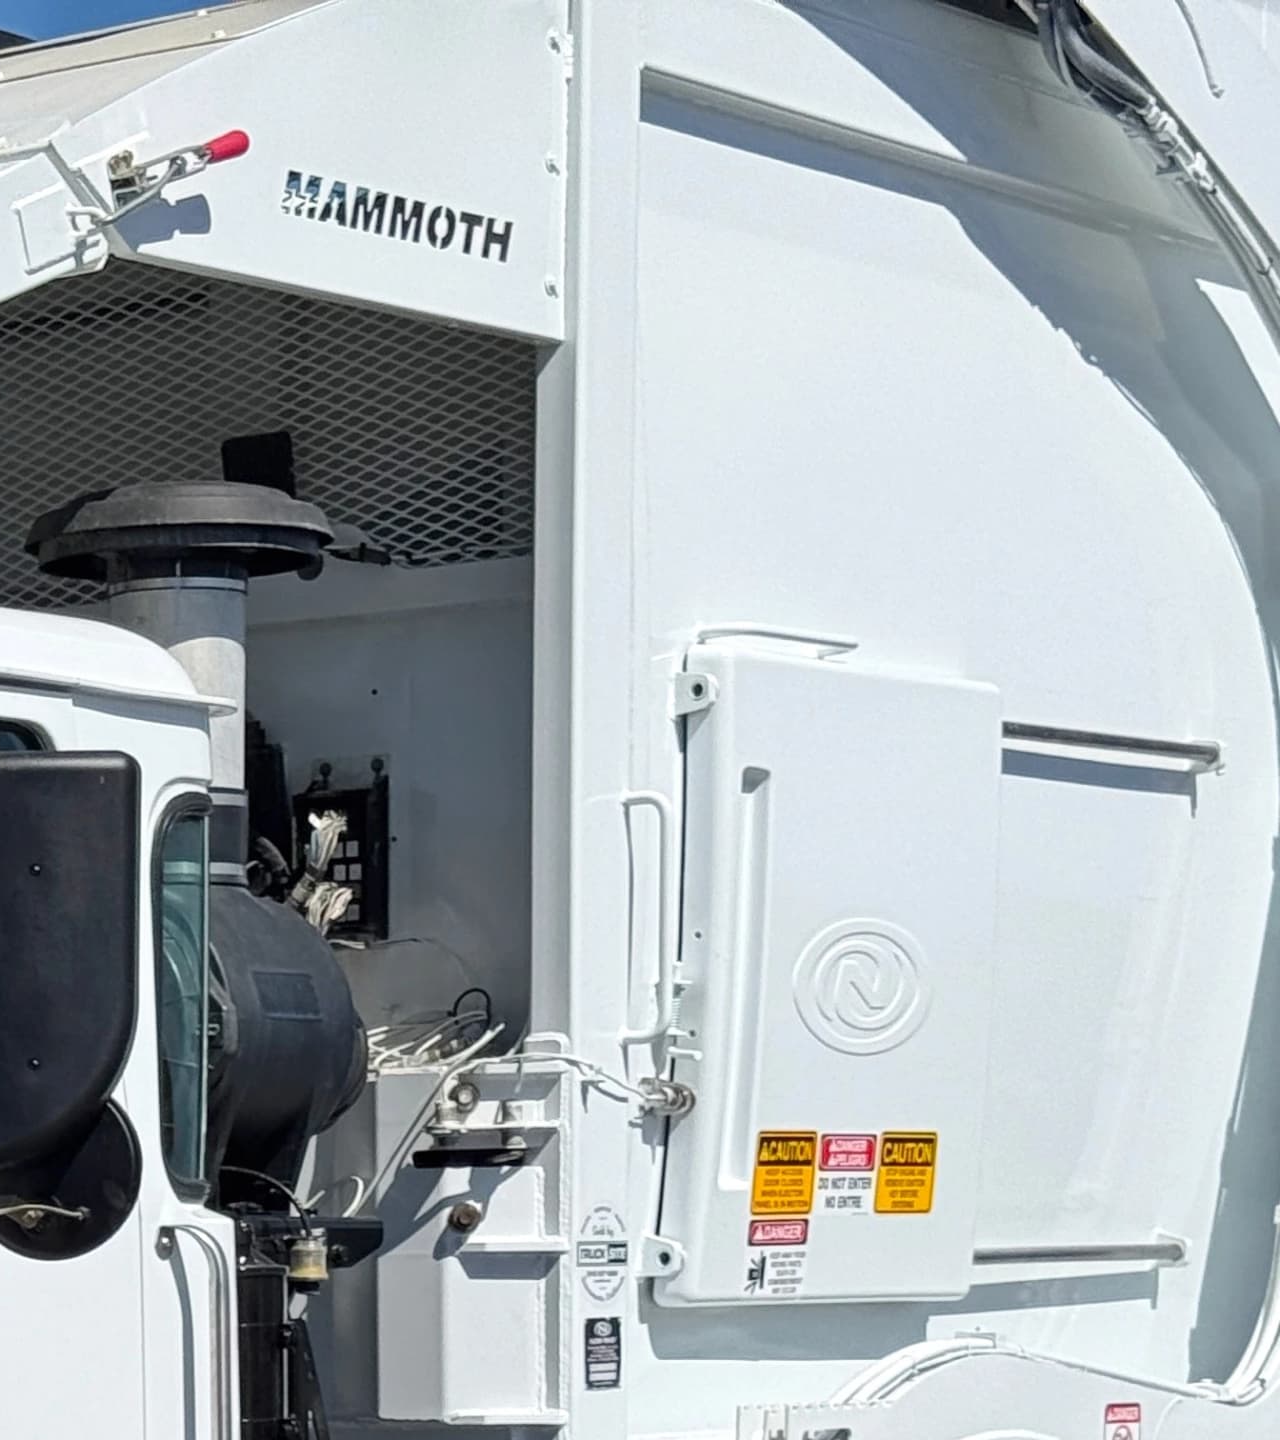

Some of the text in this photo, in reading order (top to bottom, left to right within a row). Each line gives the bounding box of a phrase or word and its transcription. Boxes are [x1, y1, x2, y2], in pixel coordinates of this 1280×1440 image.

[281, 169, 513, 262] MAMMOTH
[768, 1141, 812, 1161] CAUTION
[883, 1142, 932, 1163] CAUTION
